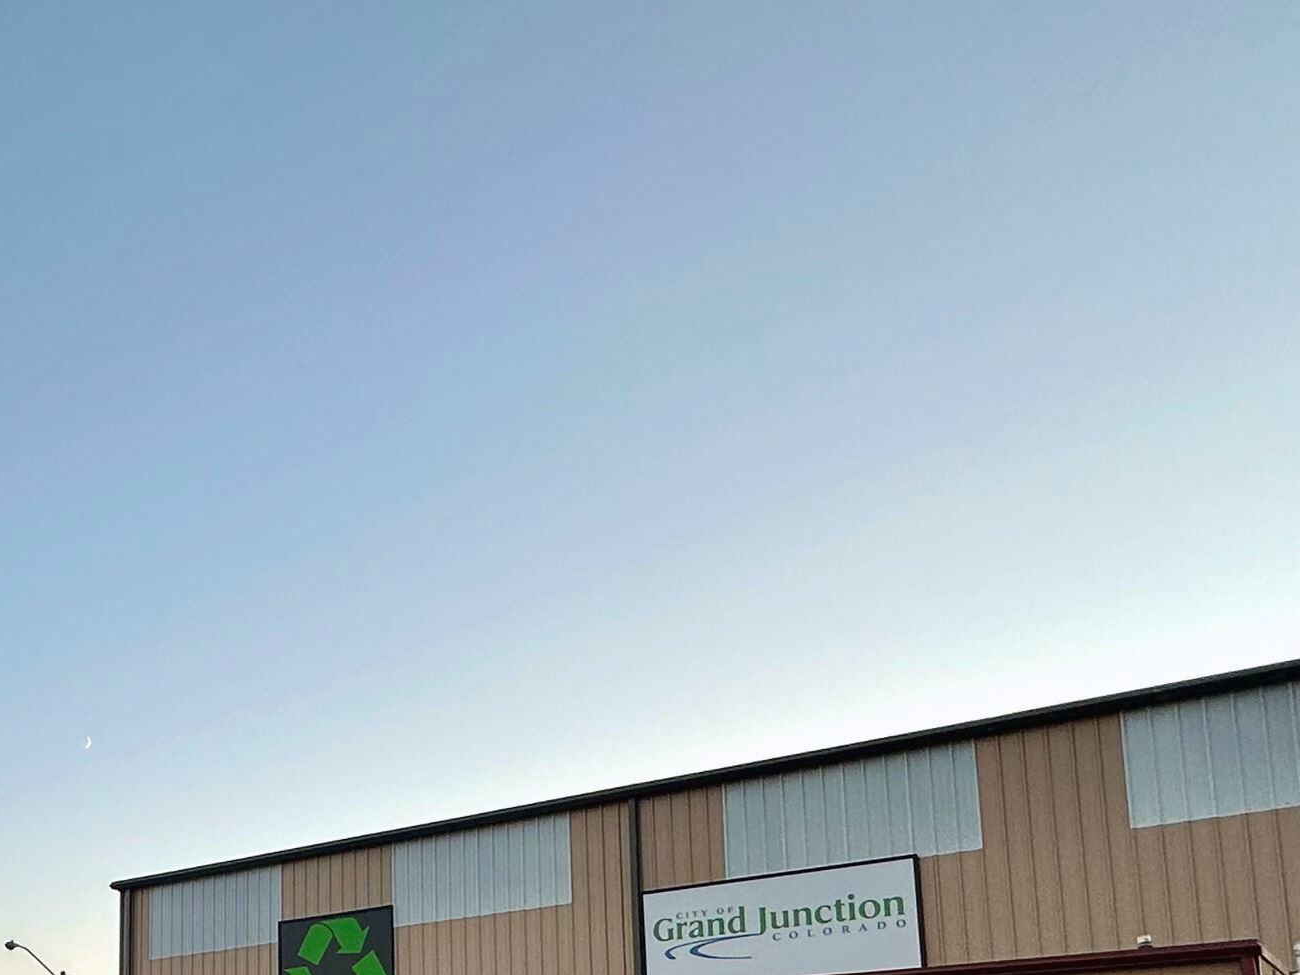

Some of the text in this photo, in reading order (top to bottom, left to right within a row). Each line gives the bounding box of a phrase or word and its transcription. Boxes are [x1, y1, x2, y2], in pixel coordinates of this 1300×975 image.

[653, 893, 906, 942] Grand Junction
[675, 906, 734, 920] CITY OF
[771, 918, 907, 941] COLORADO
